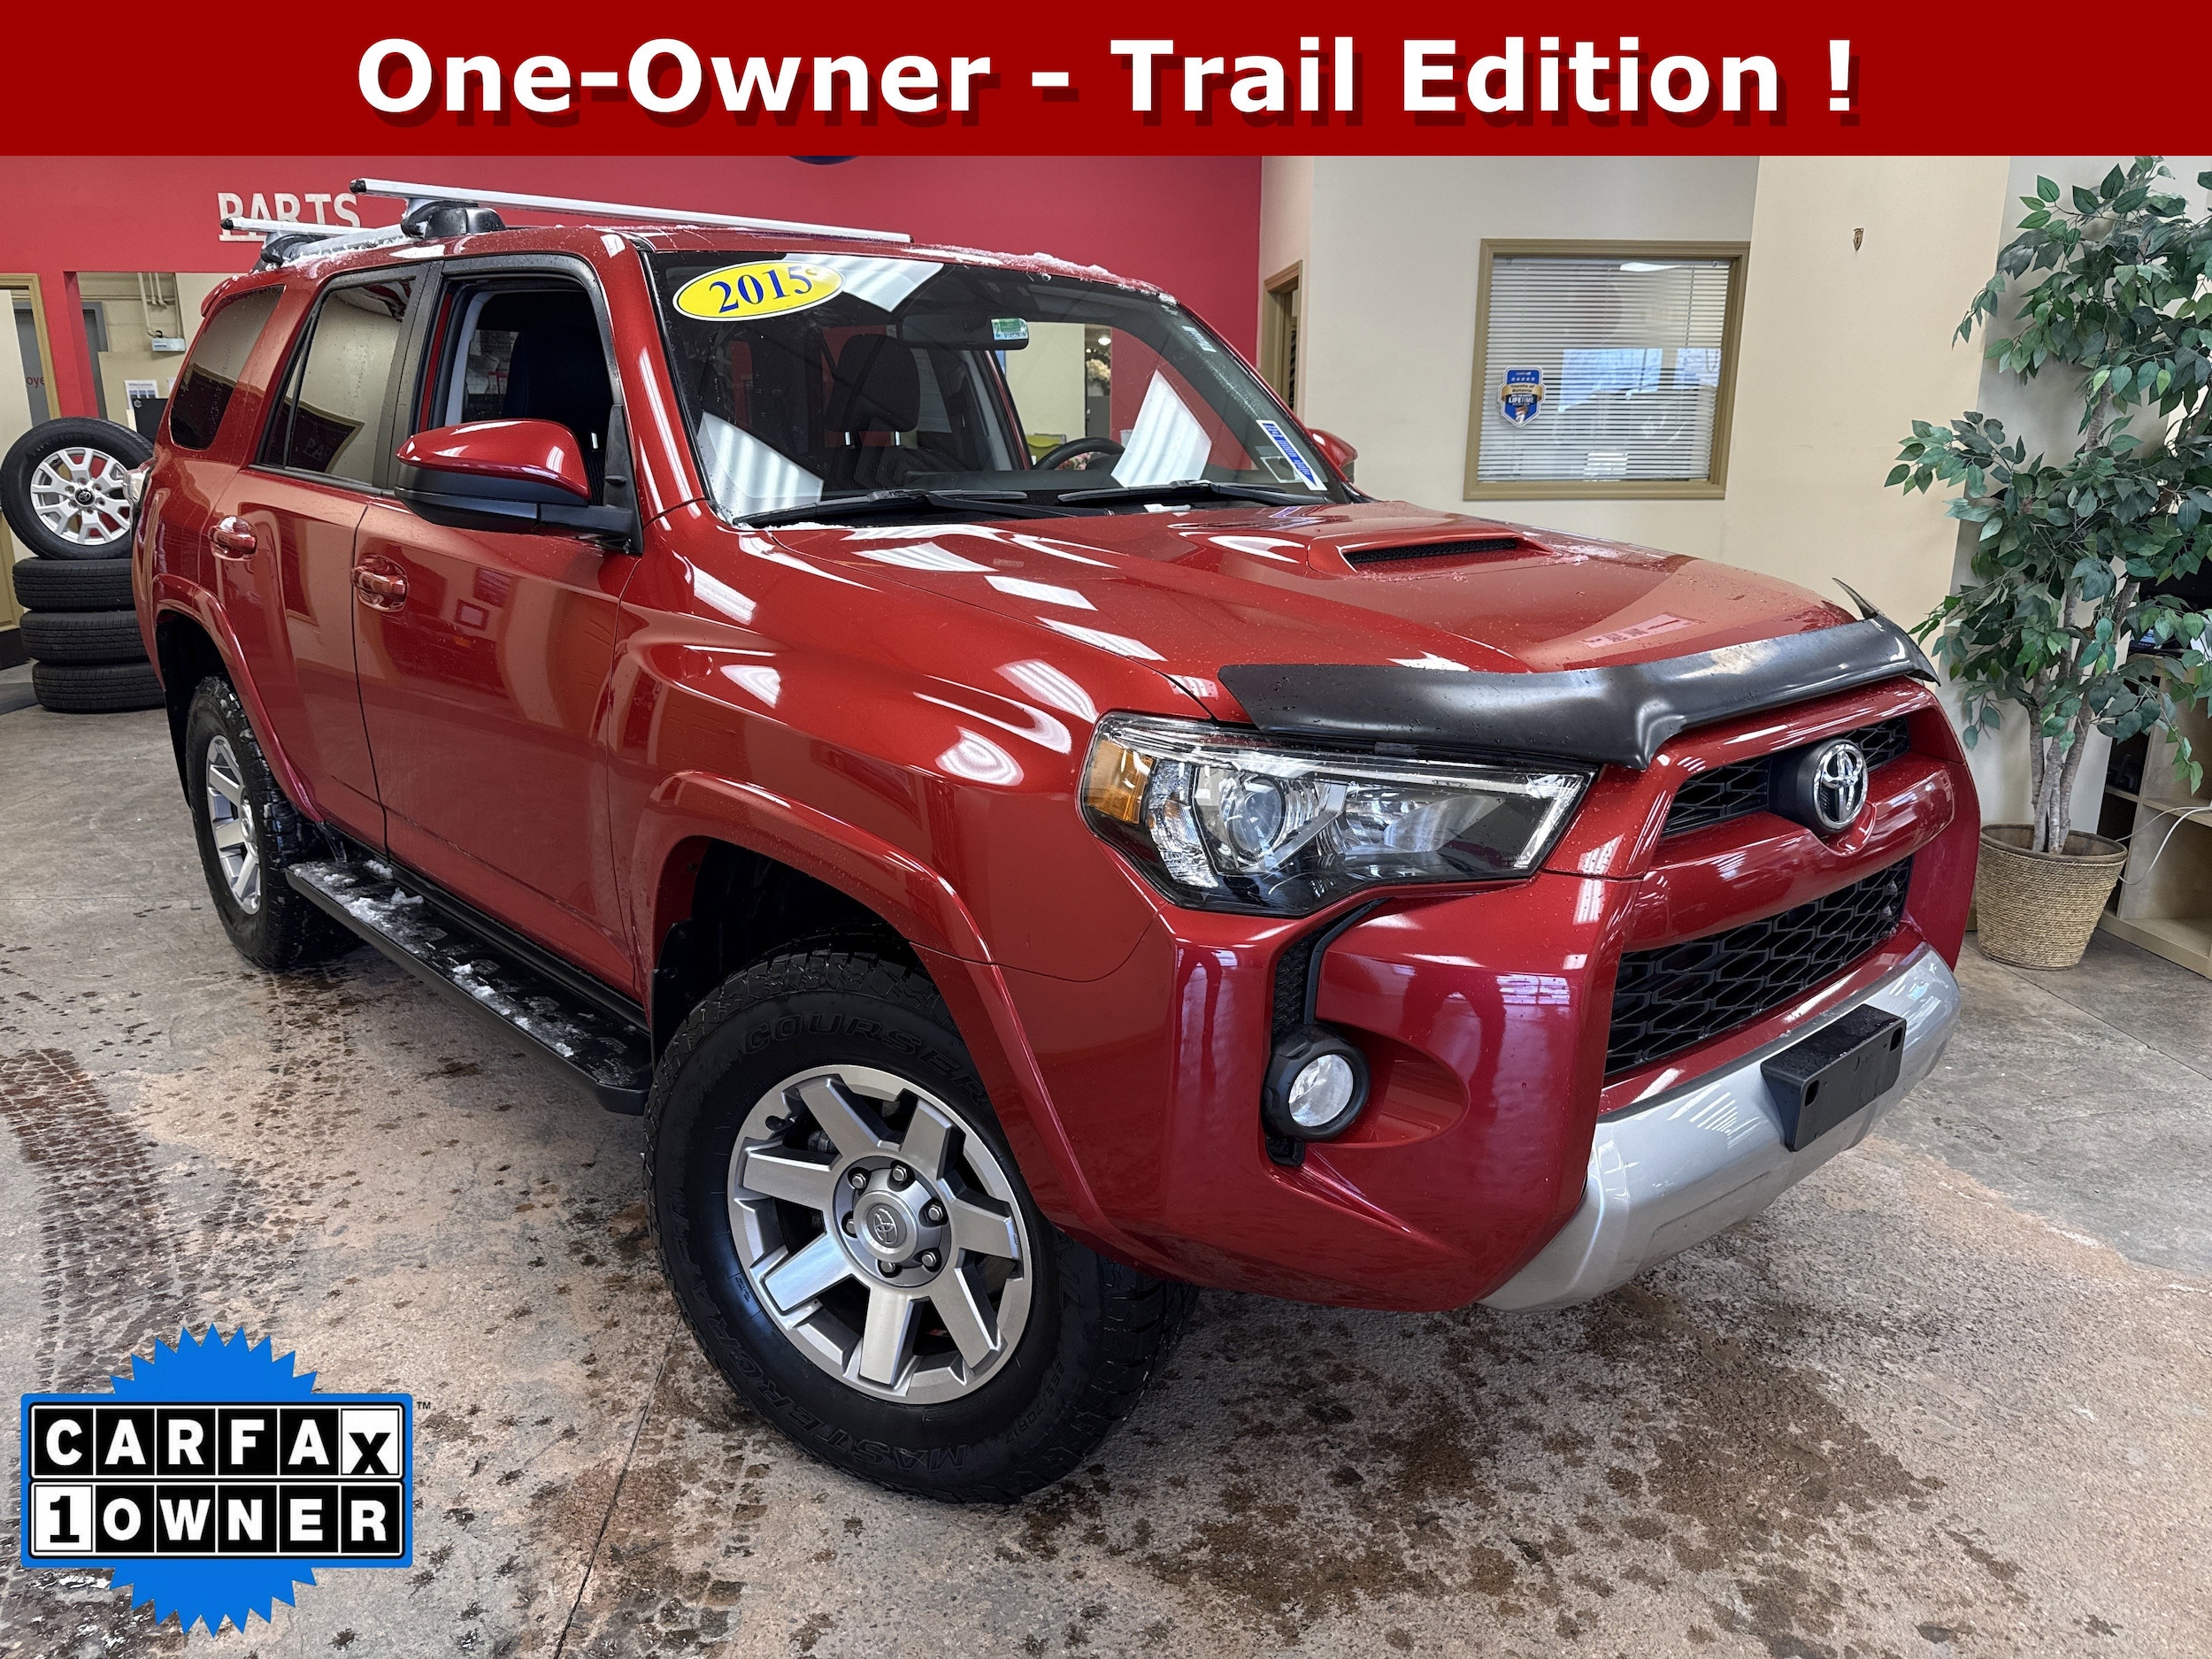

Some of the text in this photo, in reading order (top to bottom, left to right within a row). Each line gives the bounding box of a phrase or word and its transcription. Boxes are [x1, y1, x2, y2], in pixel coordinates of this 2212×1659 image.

[218, 192, 361, 238] PARTS
[710, 266, 812, 313] 2015
[745, 1012, 992, 1105] COURSER
